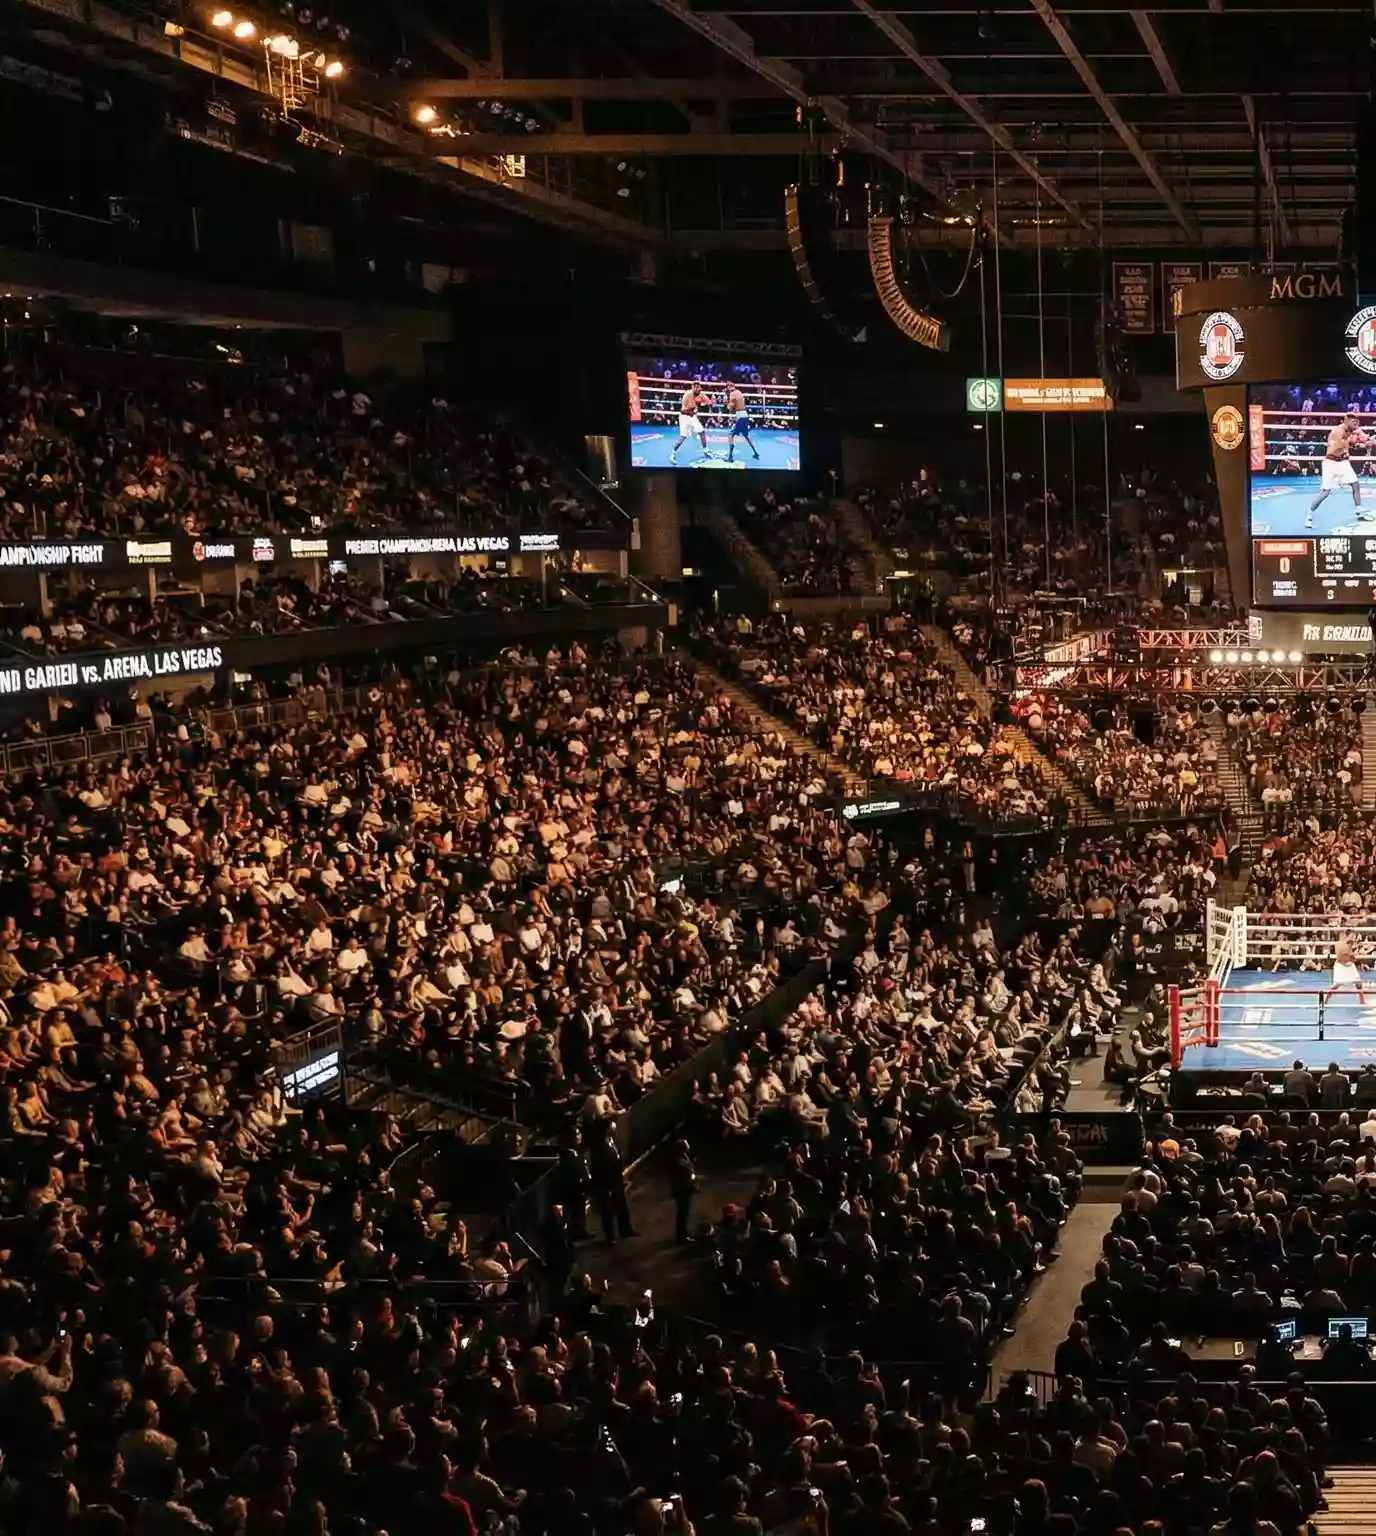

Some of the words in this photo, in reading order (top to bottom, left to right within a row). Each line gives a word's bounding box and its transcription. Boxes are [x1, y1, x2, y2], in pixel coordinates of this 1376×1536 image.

[1270, 274, 1343, 299] MGM
[70, 544, 104, 564] FIGHT
[457, 537, 477, 552] LAS
[154, 650, 180, 674] LAS
[181, 646, 222, 671] VEGAS
